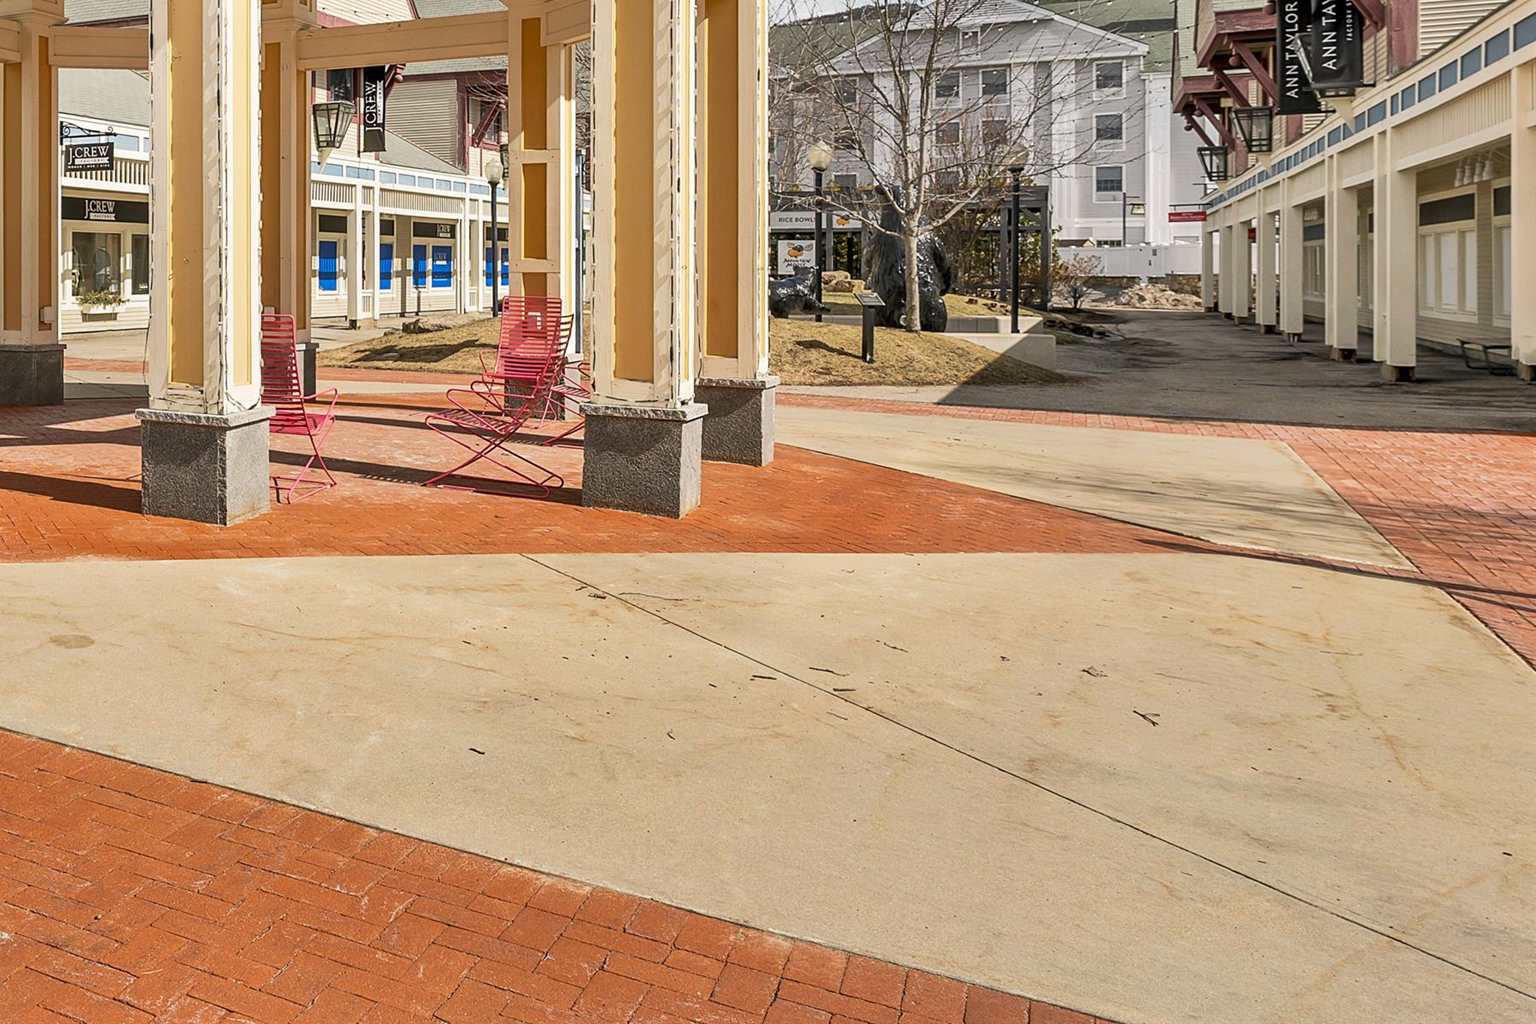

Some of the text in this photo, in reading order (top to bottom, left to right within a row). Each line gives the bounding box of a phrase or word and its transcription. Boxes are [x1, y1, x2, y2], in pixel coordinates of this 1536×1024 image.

[1285, 1, 1299, 98] ANN TAYLOR
[1322, 31, 1337, 70] ANN
[365, 81, 383, 133] J.CREW
[67, 145, 110, 166] J.CREW
[84, 199, 116, 220] J.CREW
